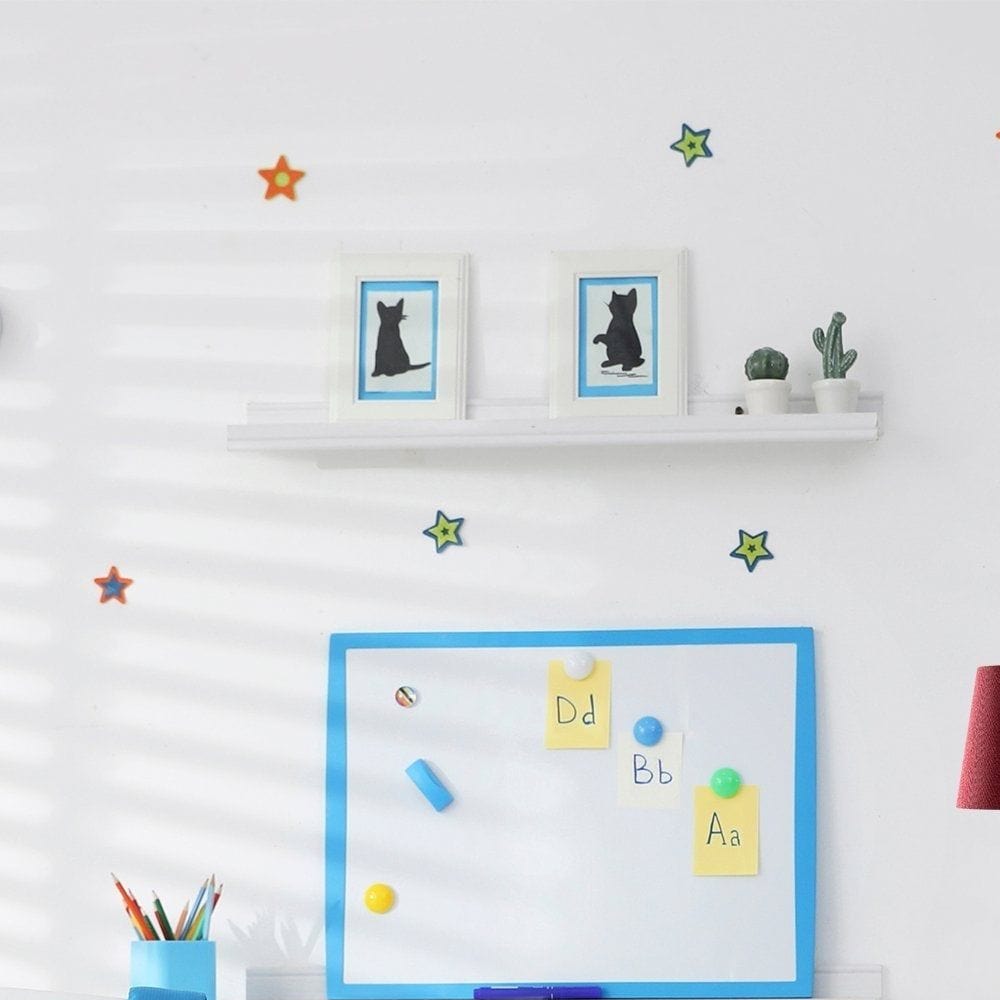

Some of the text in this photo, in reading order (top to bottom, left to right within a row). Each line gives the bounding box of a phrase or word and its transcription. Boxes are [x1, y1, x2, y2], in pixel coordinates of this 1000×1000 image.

[556, 694, 596, 725] Dd
[633, 754, 673, 784] Bb
[706, 812, 741, 846] Aa
